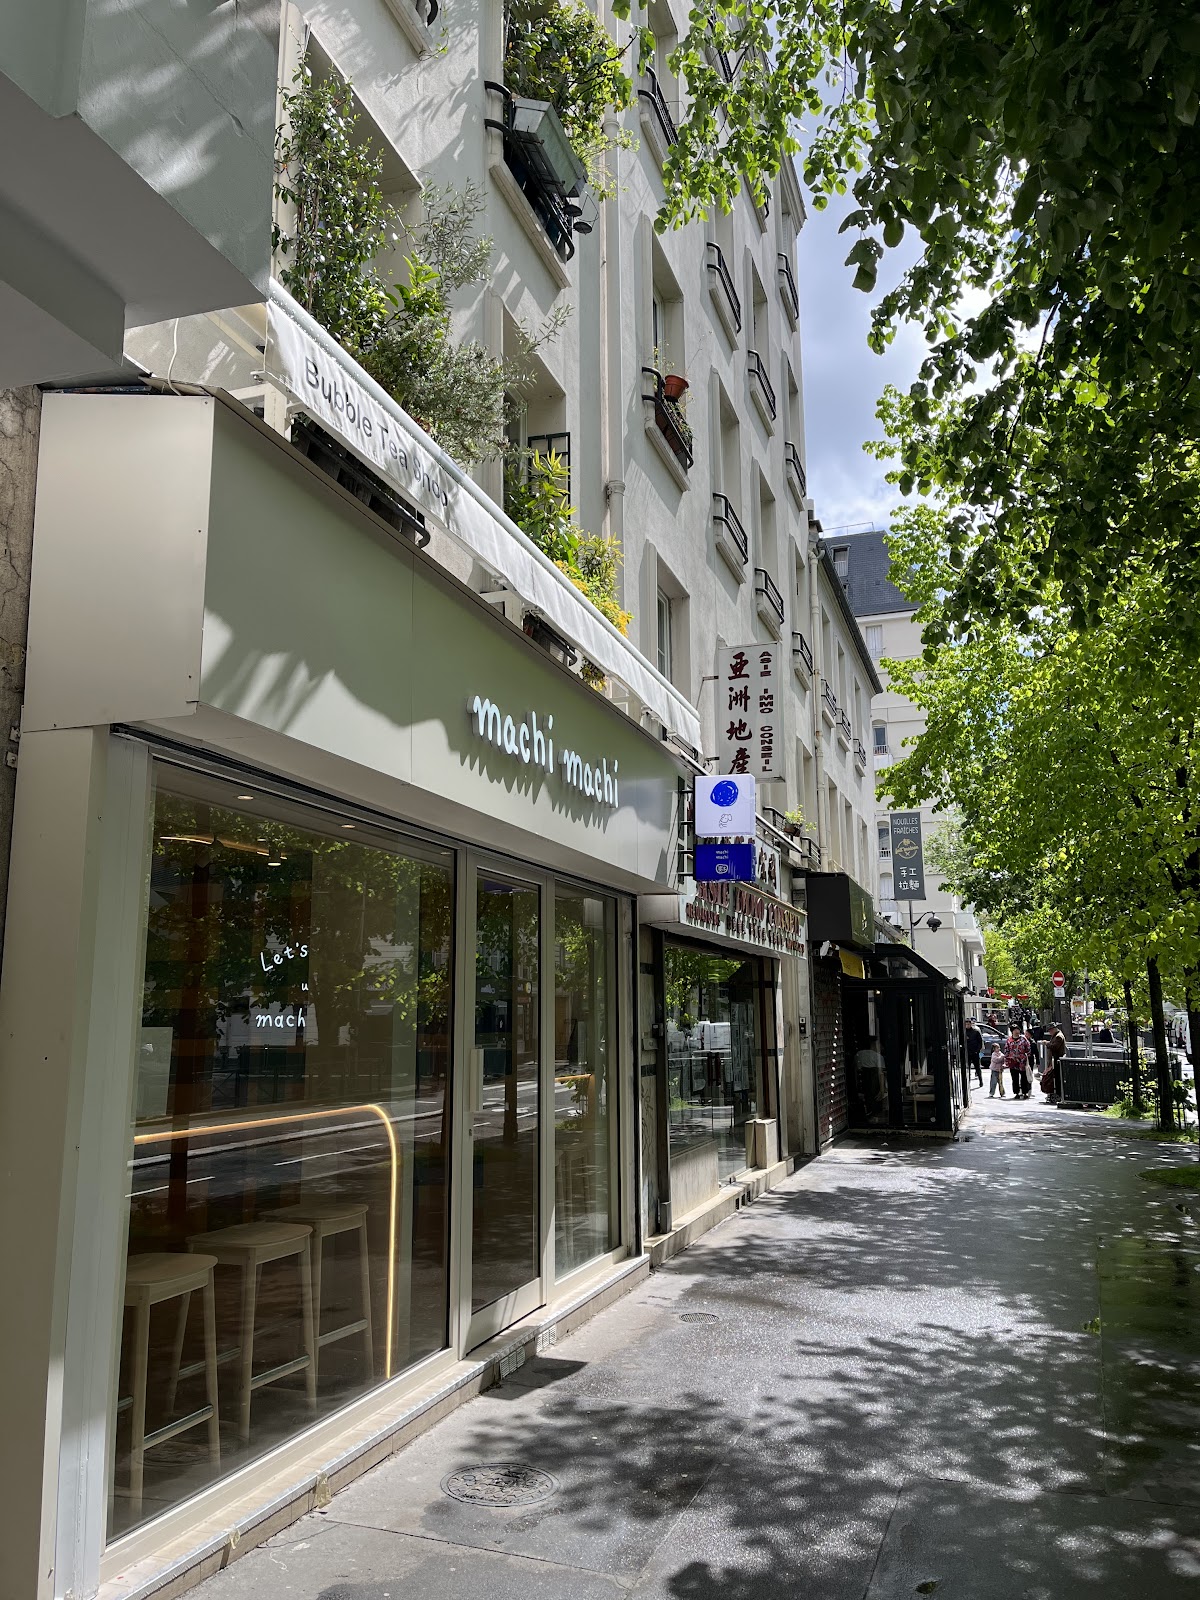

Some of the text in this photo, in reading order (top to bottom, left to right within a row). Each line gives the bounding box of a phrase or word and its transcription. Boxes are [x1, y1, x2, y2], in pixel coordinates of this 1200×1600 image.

[304, 356, 448, 507] Bubble Tea Shop
[758, 651, 774, 772] ASIE IMMO CONSEIL
[470, 695, 619, 808] machi machi
[899, 866, 917, 878] 手工
[260, 941, 308, 972] Let's
[255, 1007, 306, 1029] mach
